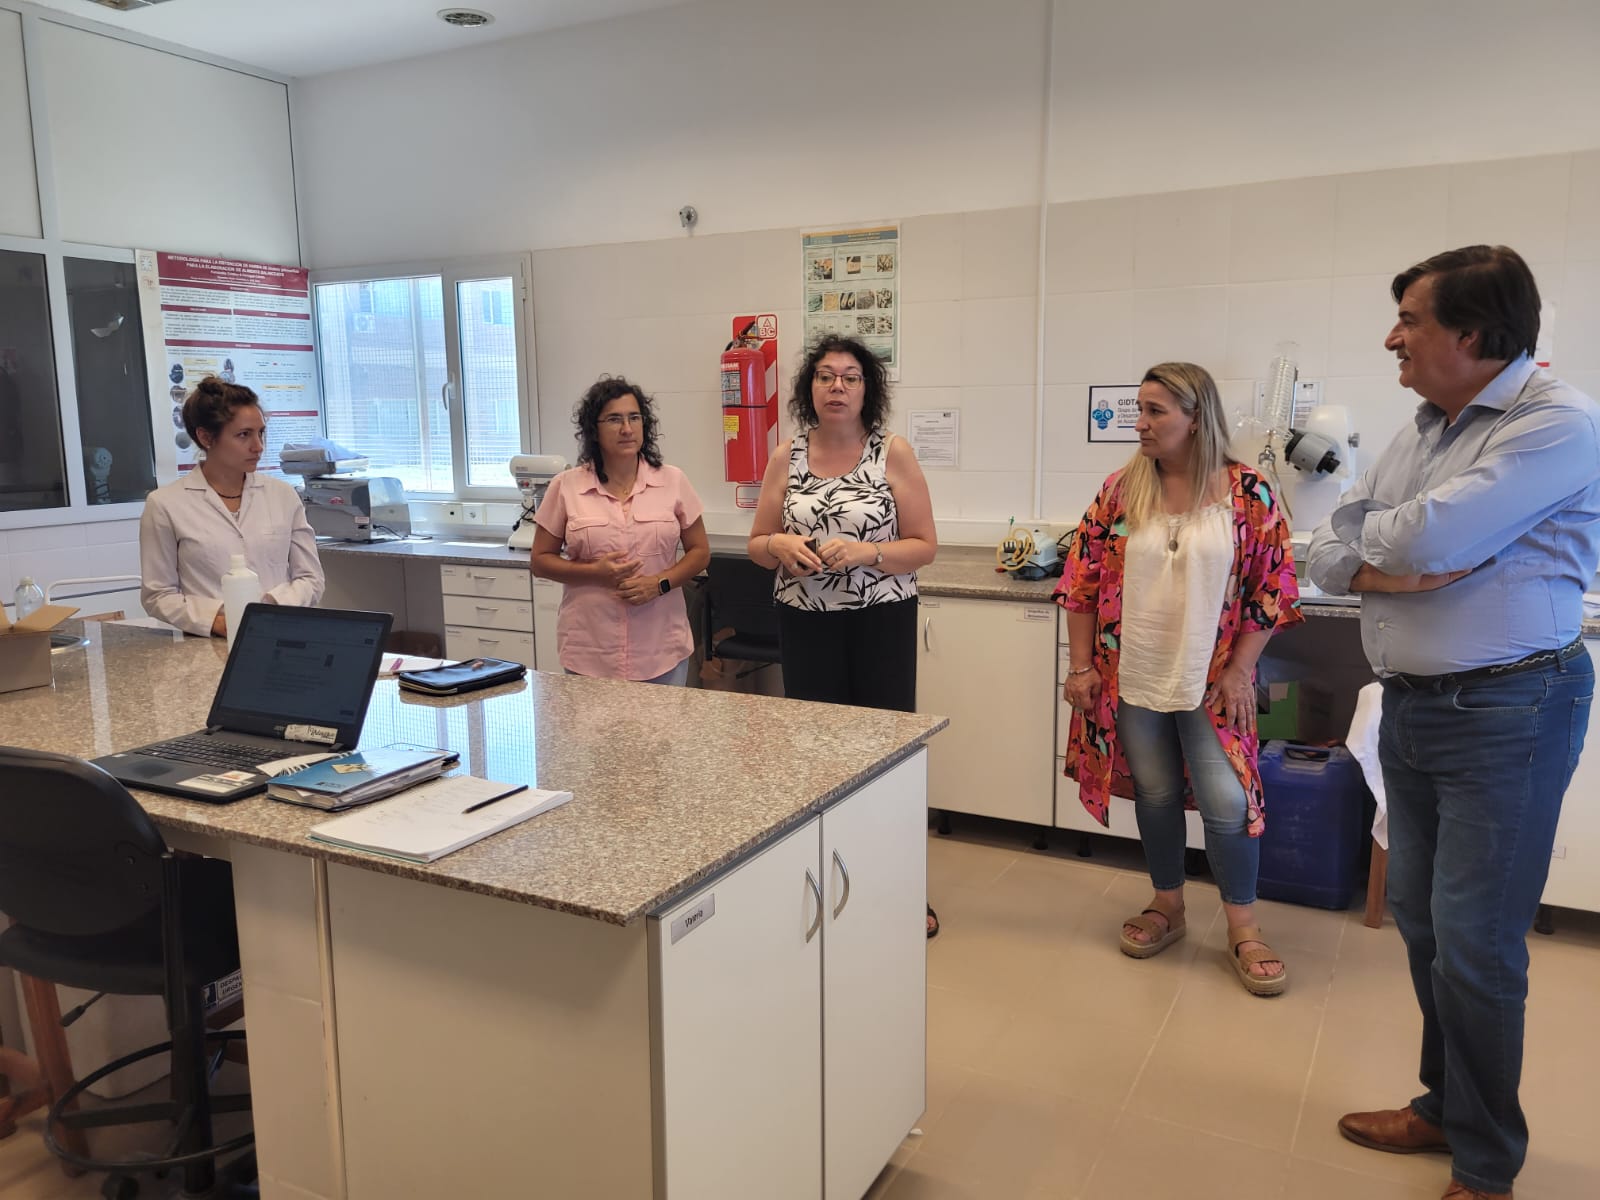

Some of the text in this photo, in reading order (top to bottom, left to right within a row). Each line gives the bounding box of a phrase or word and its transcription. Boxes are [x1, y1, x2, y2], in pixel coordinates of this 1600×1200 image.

[763, 318, 772, 327] A
[760, 328, 775, 336] B C
